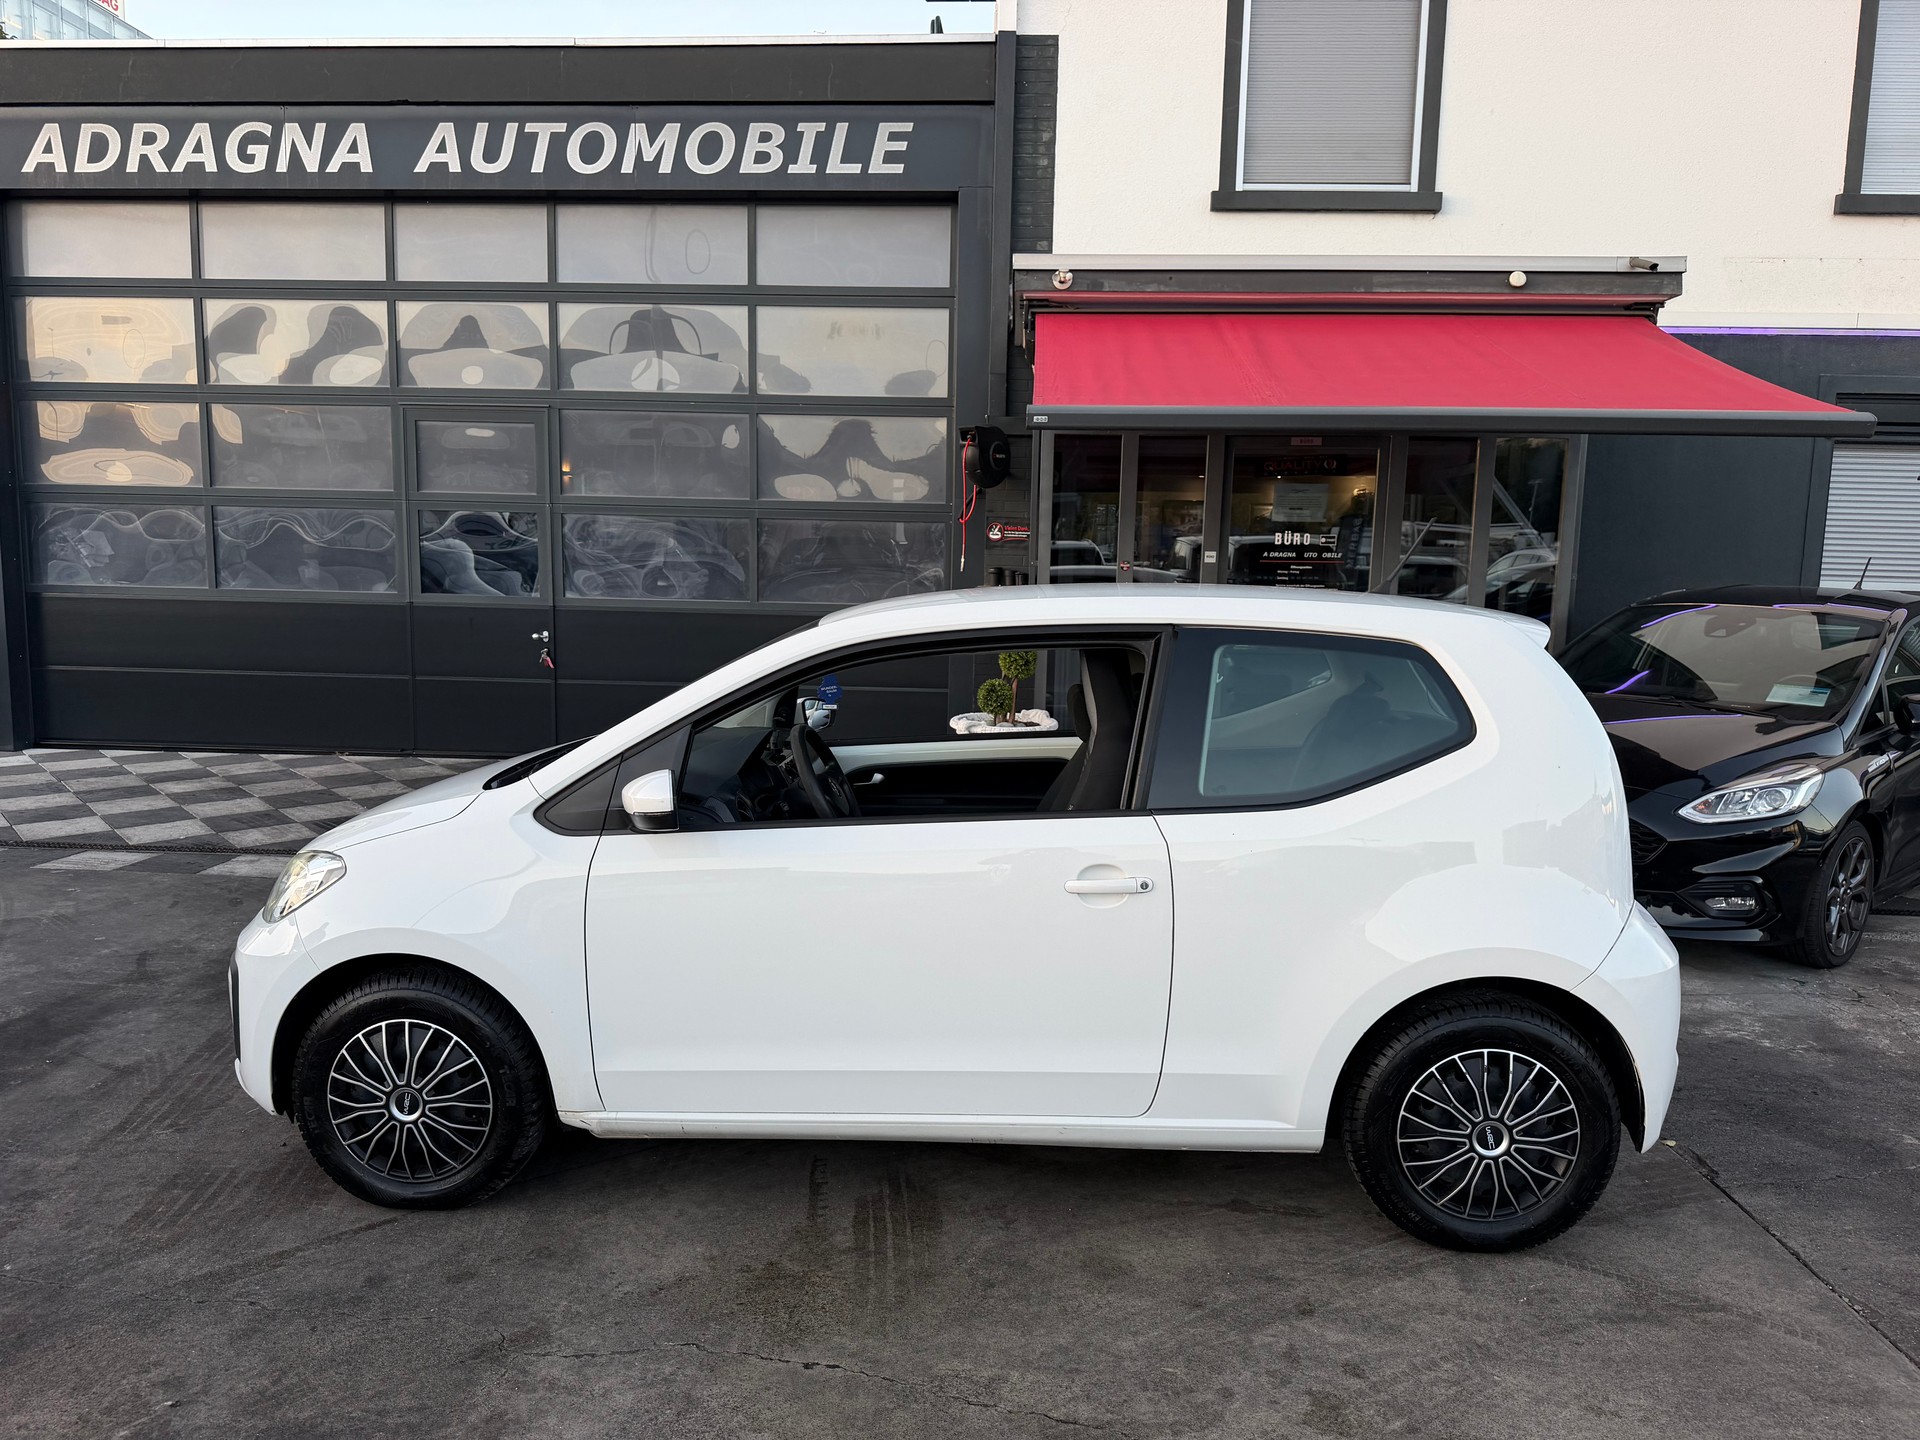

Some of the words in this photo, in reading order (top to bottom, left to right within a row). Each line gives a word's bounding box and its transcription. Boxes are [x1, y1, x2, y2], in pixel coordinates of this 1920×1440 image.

[20, 121, 374, 174] ADRAGNA
[413, 121, 914, 175] AUTOMOBILE
[1274, 531, 1310, 545] BÜRO
